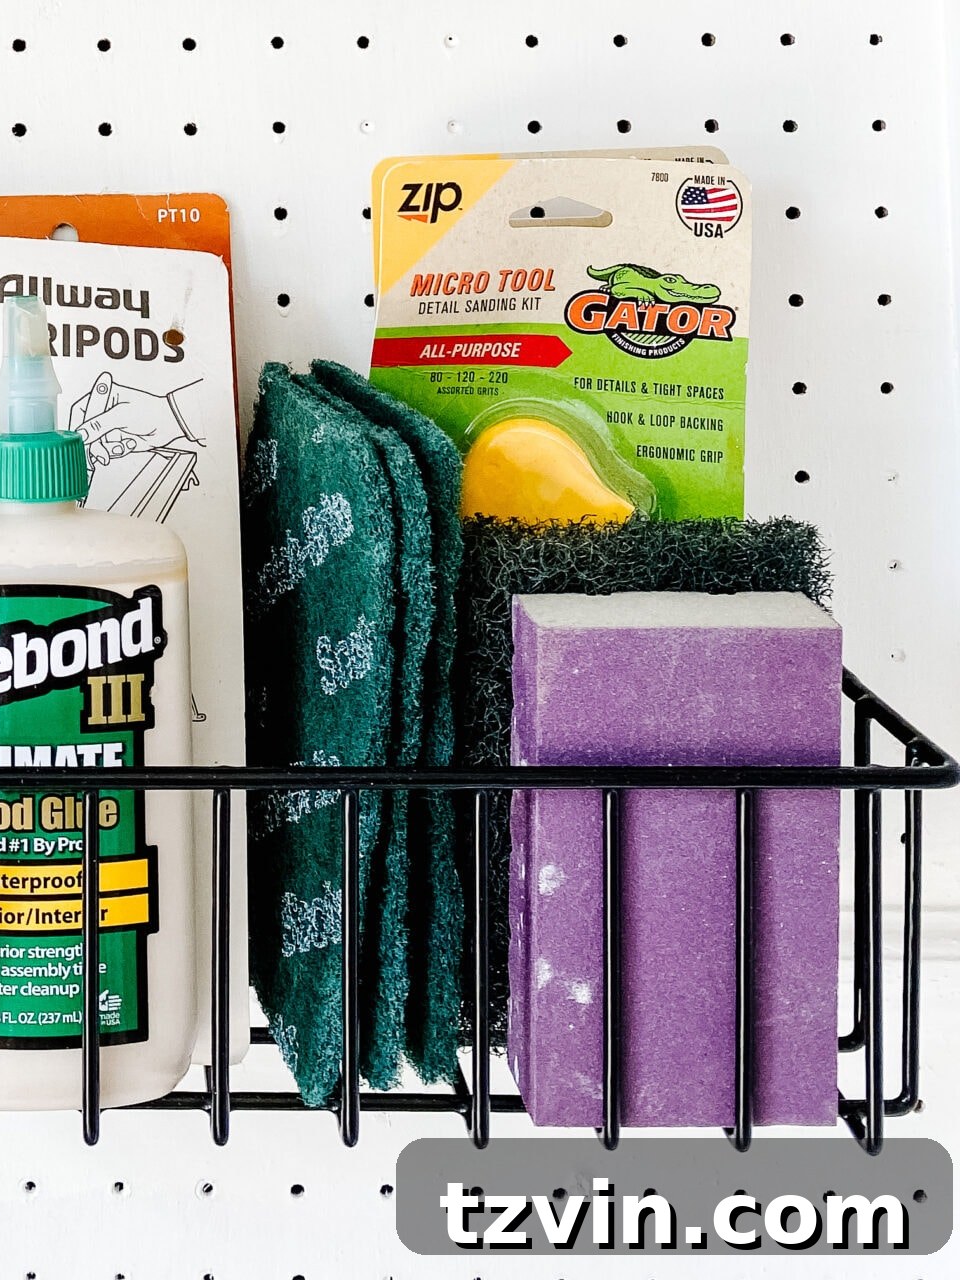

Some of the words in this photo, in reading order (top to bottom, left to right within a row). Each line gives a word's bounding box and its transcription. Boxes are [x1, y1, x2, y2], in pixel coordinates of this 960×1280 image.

[651, 172, 669, 183] 7800
[694, 174, 715, 185] MADE
[717, 176, 726, 186] IN
[157, 208, 201, 223] PT10
[693, 222, 724, 238] USA
[410, 271, 491, 297] MICRO
[498, 268, 557, 293] TOOL
[418, 301, 460, 315] DETAIL
[465, 298, 517, 313] SANDING
[521, 297, 541, 311] KIT
[567, 292, 734, 339] GATOR
[419, 342, 522, 359] ALL-PURPOSE
[612, 333, 647, 357] FINISHING
[648, 338, 686, 357] PRODUCTS
[430, 371, 443, 383] 80
[456, 371, 475, 383] 120
[489, 371, 508, 384] 220
[437, 386, 474, 395] ASSORTED
[477, 386, 499, 396] GRITS
[574, 376, 592, 390] FOR
[597, 379, 637, 394] DETAILS
[641, 382, 648, 394] &
[653, 382, 682, 397] TIGHT
[686, 385, 724, 400] SPACES
[607, 411, 633, 425] HOOK
[638, 413, 645, 425] &
[650, 414, 675, 428] LOOP
[680, 416, 723, 431] BACKING
[636, 445, 695, 461] ERGONOMIC
[700, 450, 724, 463] GRIP
[86, 673, 146, 726] III
[9, 838, 29, 852] #1
[33, 837, 56, 856] By
[1, 963, 71, 981] assembly
[72, 961, 107, 976] tie
[20, 982, 81, 998] cleanup
[38, 1012, 61, 1026] (237
[62, 1011, 83, 1024] mL)
